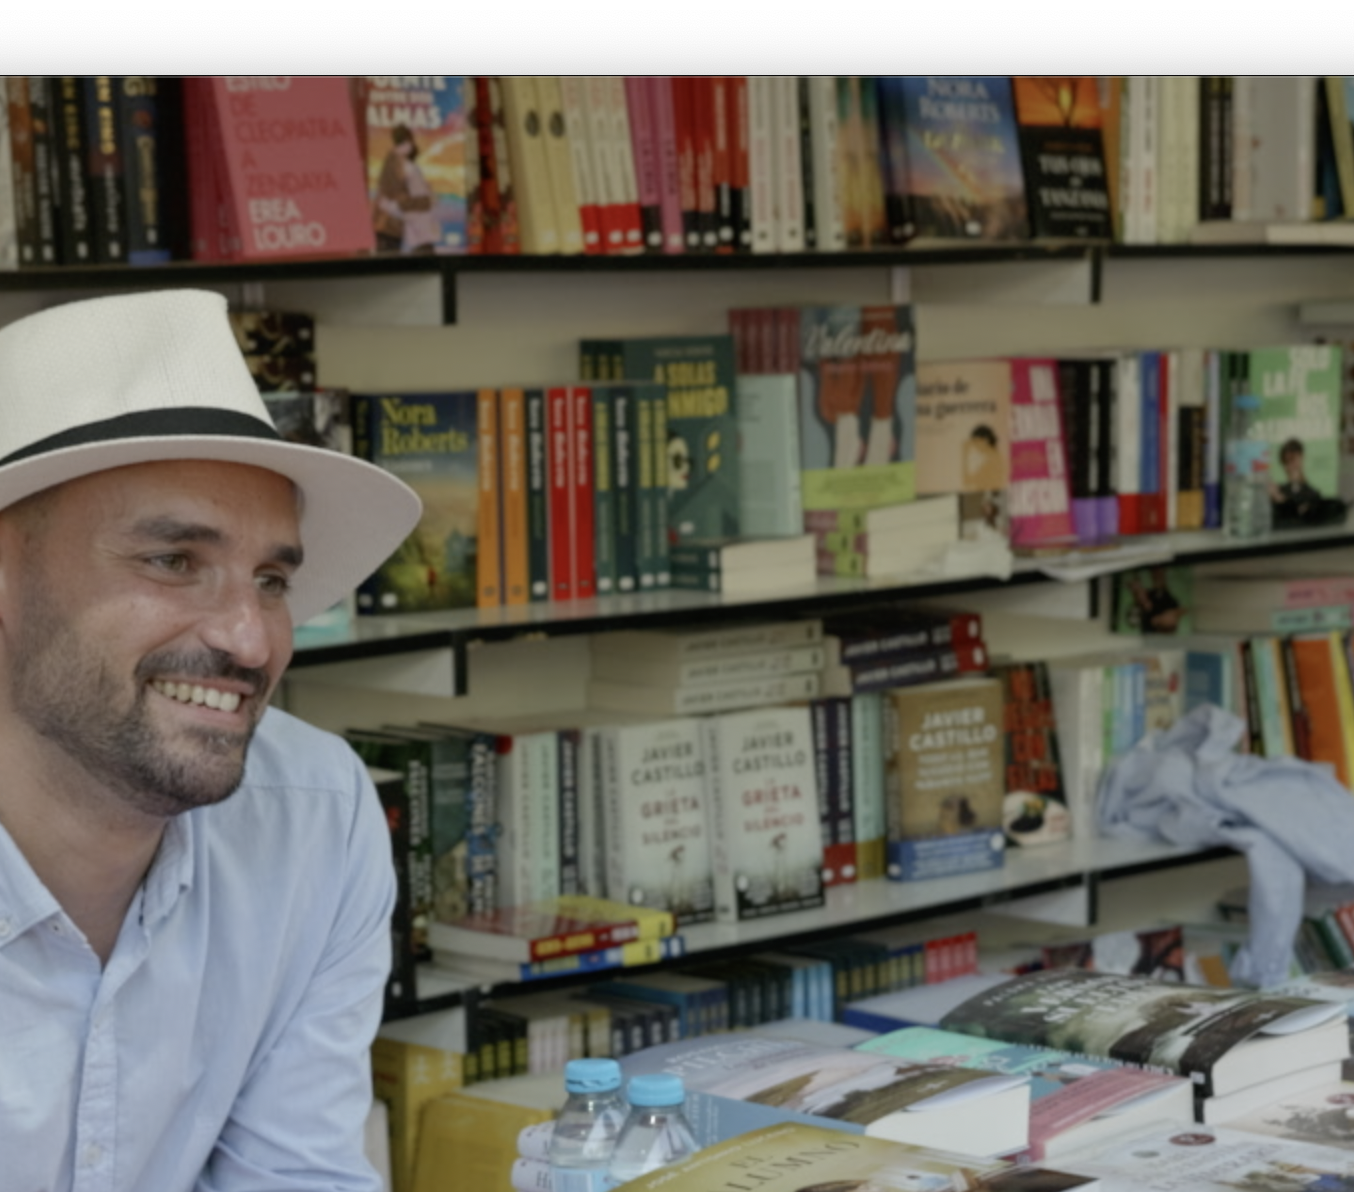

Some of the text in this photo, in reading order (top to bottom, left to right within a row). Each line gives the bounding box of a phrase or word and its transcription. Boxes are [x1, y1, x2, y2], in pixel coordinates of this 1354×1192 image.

[366, 104, 443, 129] ALMAS
[233, 116, 347, 144] CLEOPATRA
[245, 171, 340, 198] ZENDAYA
[248, 198, 303, 223] EREA
[253, 222, 326, 252] LOURO
[379, 396, 437, 428] Nora
[380, 428, 469, 456] Roberts
[920, 706, 985, 731] JAVIER
[741, 732, 795, 752] JAVIER
[908, 724, 997, 751] CASTILLO
[642, 741, 694, 763] JAVIER
[731, 751, 807, 776] CASTILLO
[631, 761, 706, 787] CASTILLO
